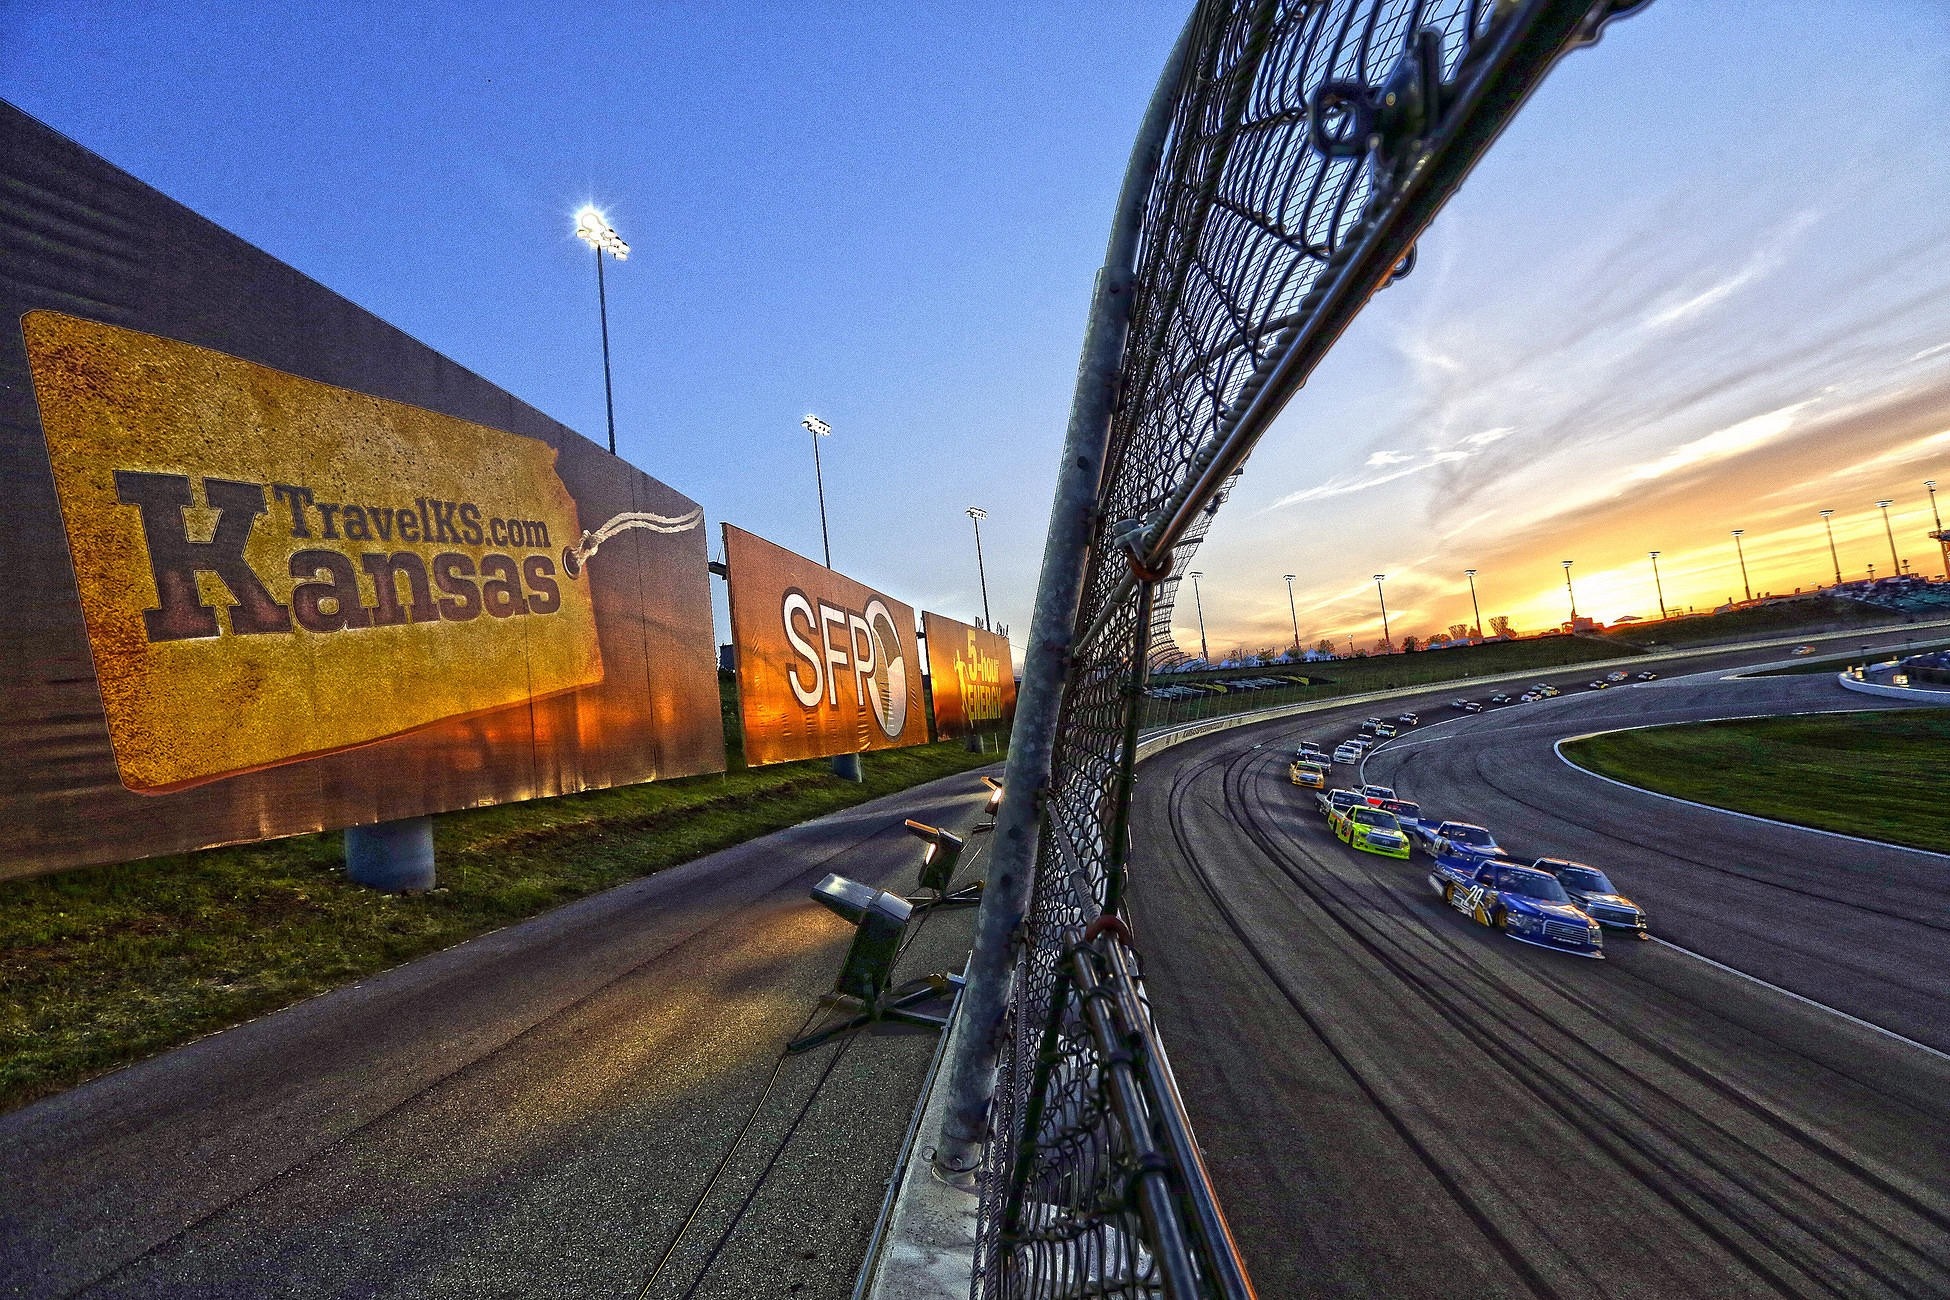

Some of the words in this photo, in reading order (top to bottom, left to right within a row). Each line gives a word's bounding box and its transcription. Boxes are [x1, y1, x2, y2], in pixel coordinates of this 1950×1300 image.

[273, 483, 552, 549] TravelKS.com
[113, 469, 561, 643] Kansas
[967, 629, 1000, 683] 5-hour
[967, 684, 1001, 720] ENERGY
[1464, 884, 1485, 911] 29
